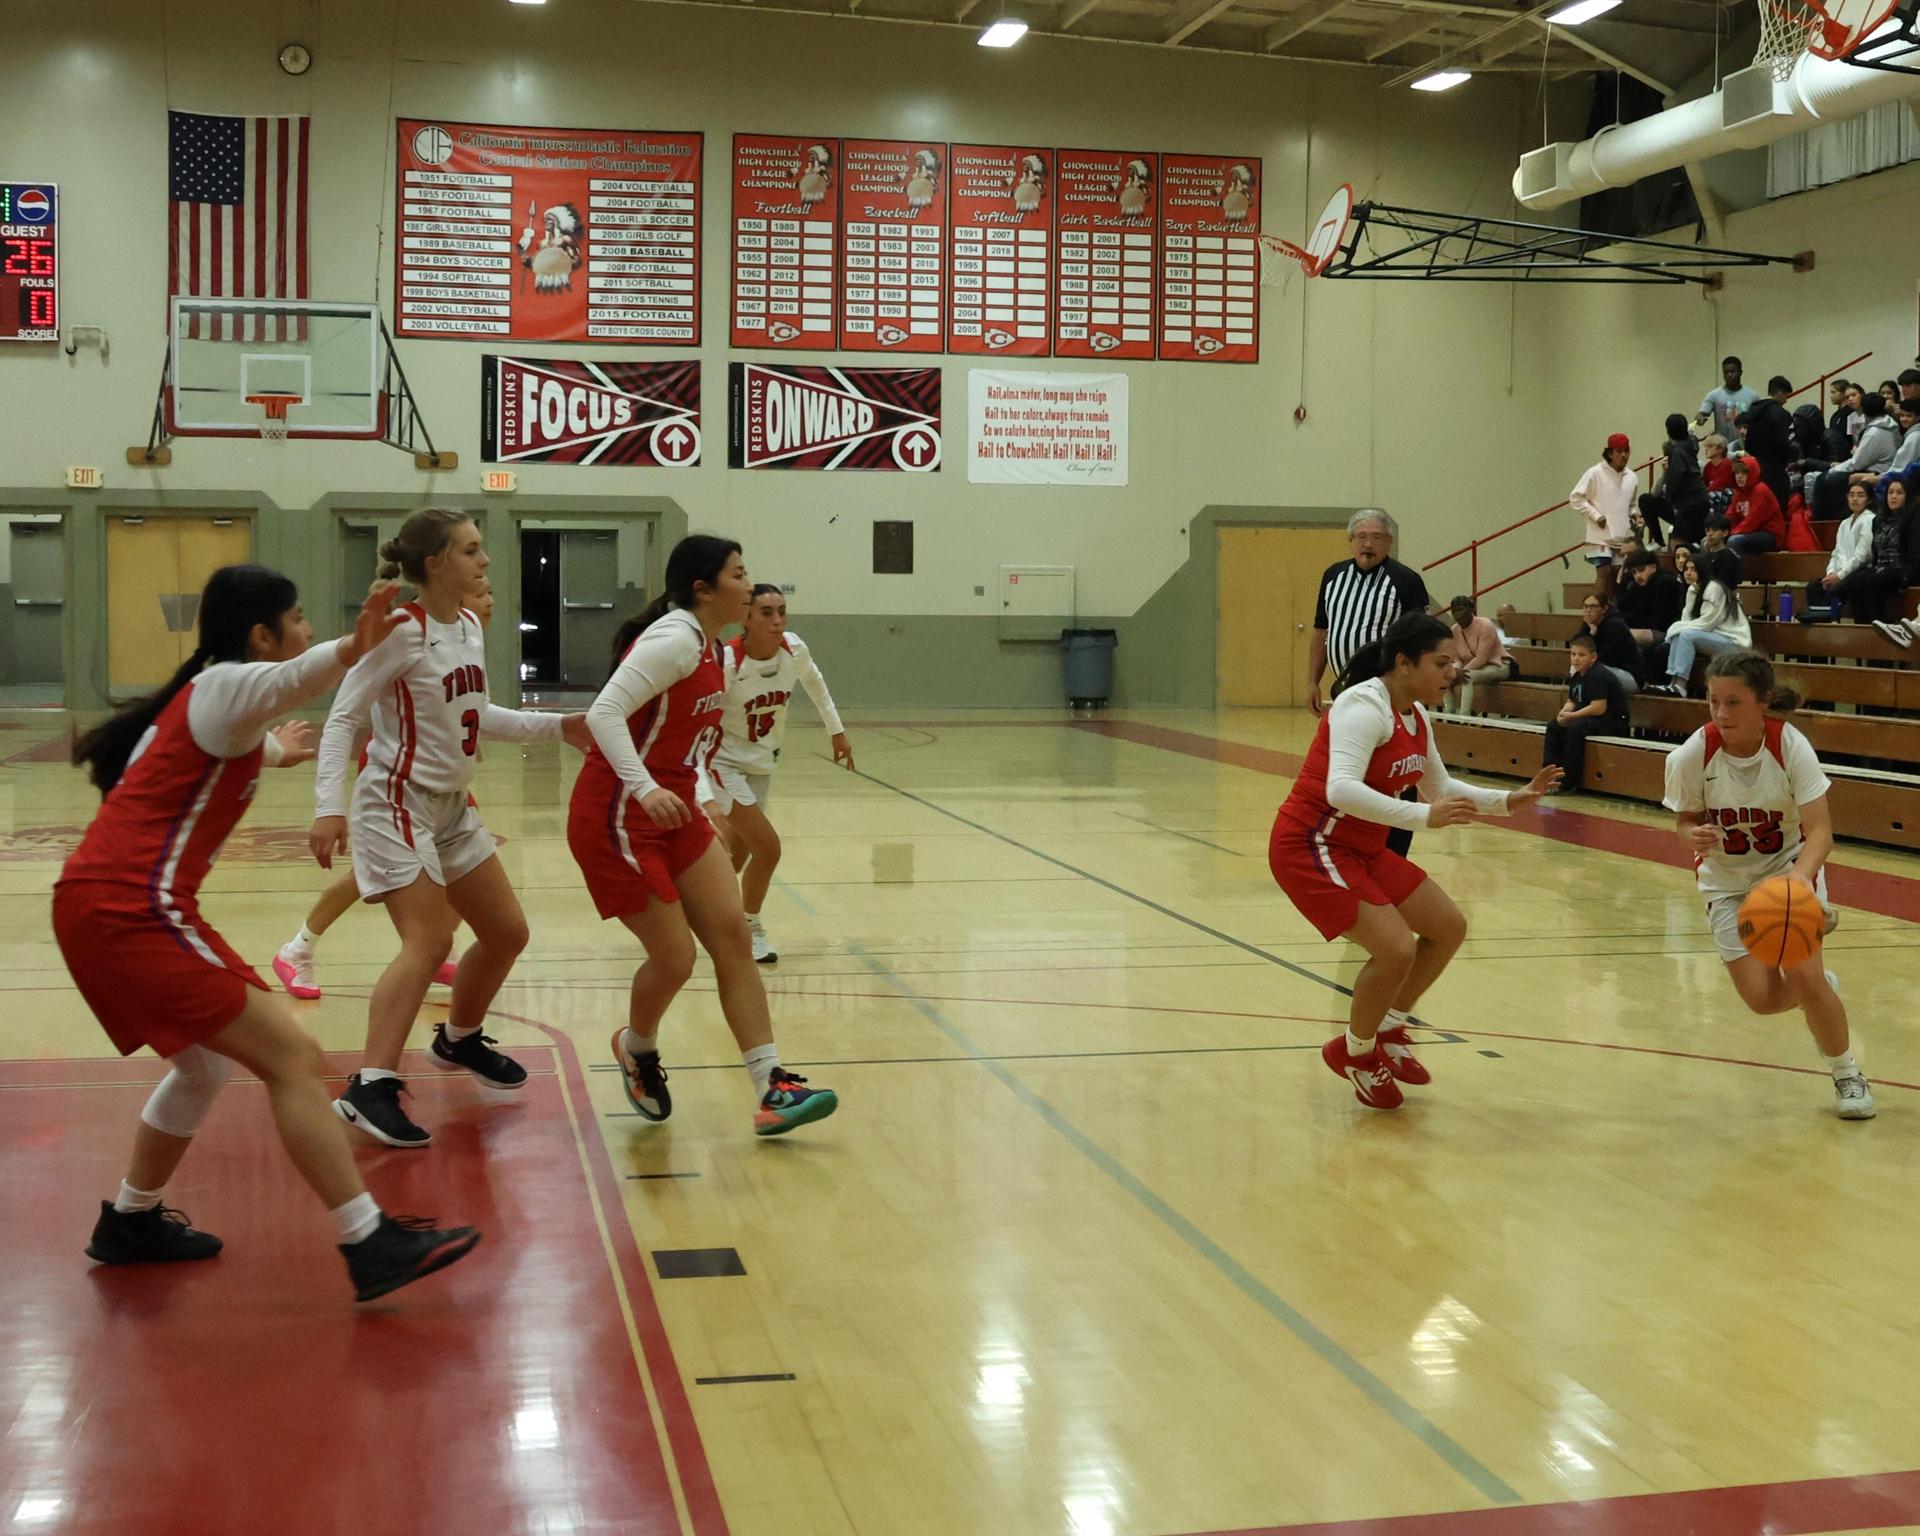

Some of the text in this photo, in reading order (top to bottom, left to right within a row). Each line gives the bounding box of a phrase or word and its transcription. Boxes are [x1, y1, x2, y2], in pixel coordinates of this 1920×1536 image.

[740, 148, 799, 157] CHOWCHILLA
[849, 152, 907, 161] CHOWCHILLA
[739, 158, 762, 166] HIGH
[957, 157, 1014, 167] CHOWCHILLA
[1063, 162, 1120, 171] CHOWCHILLA
[848, 163, 871, 171] HIGH
[955, 167, 978, 176] HIGH
[1167, 166, 1224, 176] CHOWCHILLA
[752, 170, 787, 178] LEAGUE
[860, 174, 895, 182] LEAGUE
[1061, 172, 1084, 181] HIGH
[444, 175, 495, 184] FOOTBALL
[968, 178, 1002, 187] LEAGUE
[1166, 177, 1188, 185] HIGH
[625, 183, 687, 191] VOLLEYBALL
[742, 180, 796, 189] CHAMPIONS
[850, 184, 904, 193] CHAMPIONS
[1075, 184, 1107, 192] LEAGUE
[419, 190, 493, 201] 1955 FOOTBALL
[959, 189, 1011, 198] CHAMPIONS
[1179, 188, 1213, 196] LEAGUE
[1065, 193, 1117, 202] CHAMPIONS
[607, 198, 680, 208] 2004 FOOTBALL
[1169, 198, 1220, 207] CHAMPIONS
[441, 207, 492, 217] FOOTBALL
[754, 201, 811, 215] Football
[864, 206, 919, 219] Baseball
[619, 215, 647, 223] GIRLS
[650, 216, 689, 225] SOCCER
[972, 210, 1024, 223] Softball
[1061, 214, 1152, 228] Girls Basketball
[0, 225, 47, 238] GUEST
[426, 224, 451, 232] GIRLS
[452, 225, 508, 234] BASKETBALL
[1165, 220, 1256, 234] Boys Basketball
[602, 231, 623, 239] 2005
[656, 232, 682, 240] GOLF
[1097, 235, 1116, 243] 2001
[419, 239, 494, 250] 1989 BASEBALL
[851, 241, 870, 249] 1958
[630, 248, 684, 256] BASEBALL
[4, 240, 53, 275] 26
[433, 256, 459, 265] BOYS
[463, 257, 503, 266] SOCCER
[851, 257, 870, 265] 1959
[1170, 253, 1188, 261] 1975
[607, 263, 676, 273] 2008 FOOTBALL
[959, 261, 978, 269] 1995
[418, 272, 492, 283] 1994 SOFTBALL
[742, 270, 761, 278] 1962
[20, 278, 54, 288] FOULS
[625, 280, 673, 288] SOFTBALL
[915, 276, 934, 284] 2015
[426, 289, 449, 297] BOYS
[451, 290, 505, 299] BASKETBALL
[648, 296, 678, 304] TENNIS
[30, 290, 54, 325] 0
[411, 304, 499, 315] 2002 VOLLEYBALL
[623, 311, 690, 320] FOOTBALL
[435, 322, 498, 331] VOLLEYBALL
[851, 322, 869, 330] 1981
[958, 325, 977, 333] 2005
[1043, 388, 1058, 404] long
[1060, 391, 1074, 404] may
[1076, 389, 1088, 401] she
[505, 373, 516, 446] REDSKINS
[522, 373, 632, 446] FOCUS
[751, 380, 762, 452] REDSKINS
[765, 380, 874, 453] ONWARD
[1009, 408, 1020, 419] her
[1086, 410, 1108, 422] remain
[1056, 426, 1067, 438] her
[1069, 427, 1094, 441] praises
[1095, 427, 1110, 442] long
[978, 442, 1051, 459] Hail to Chowchilla!
[74, 468, 95, 484] EXIT
[490, 473, 510, 488] EXIT
[442, 664, 486, 703] TRIB
[747, 711, 776, 742] 15
[461, 709, 479, 756] 3
